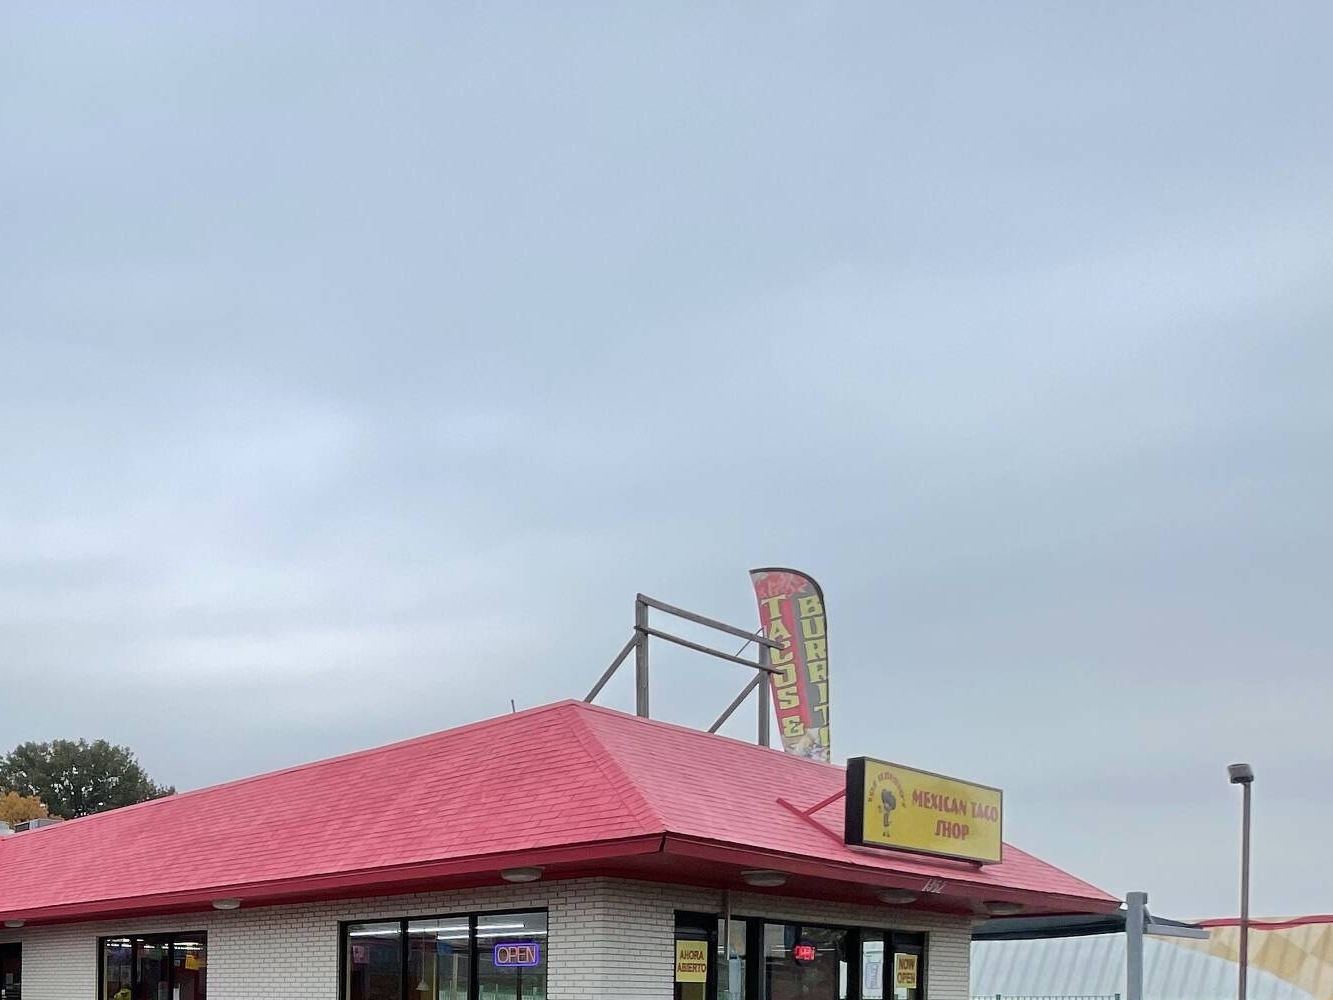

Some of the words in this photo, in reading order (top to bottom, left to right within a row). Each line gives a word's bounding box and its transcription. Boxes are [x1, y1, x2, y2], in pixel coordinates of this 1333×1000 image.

[761, 594, 800, 710] TACOS
[912, 788, 967, 816] MEXICAN
[970, 801, 999, 822] TACO
[934, 819, 970, 840] SHOP
[497, 946, 536, 963] OPEN
[680, 950, 704, 960] AHORA
[677, 962, 706, 972] ABIERTO
[898, 958, 915, 970] NOW
